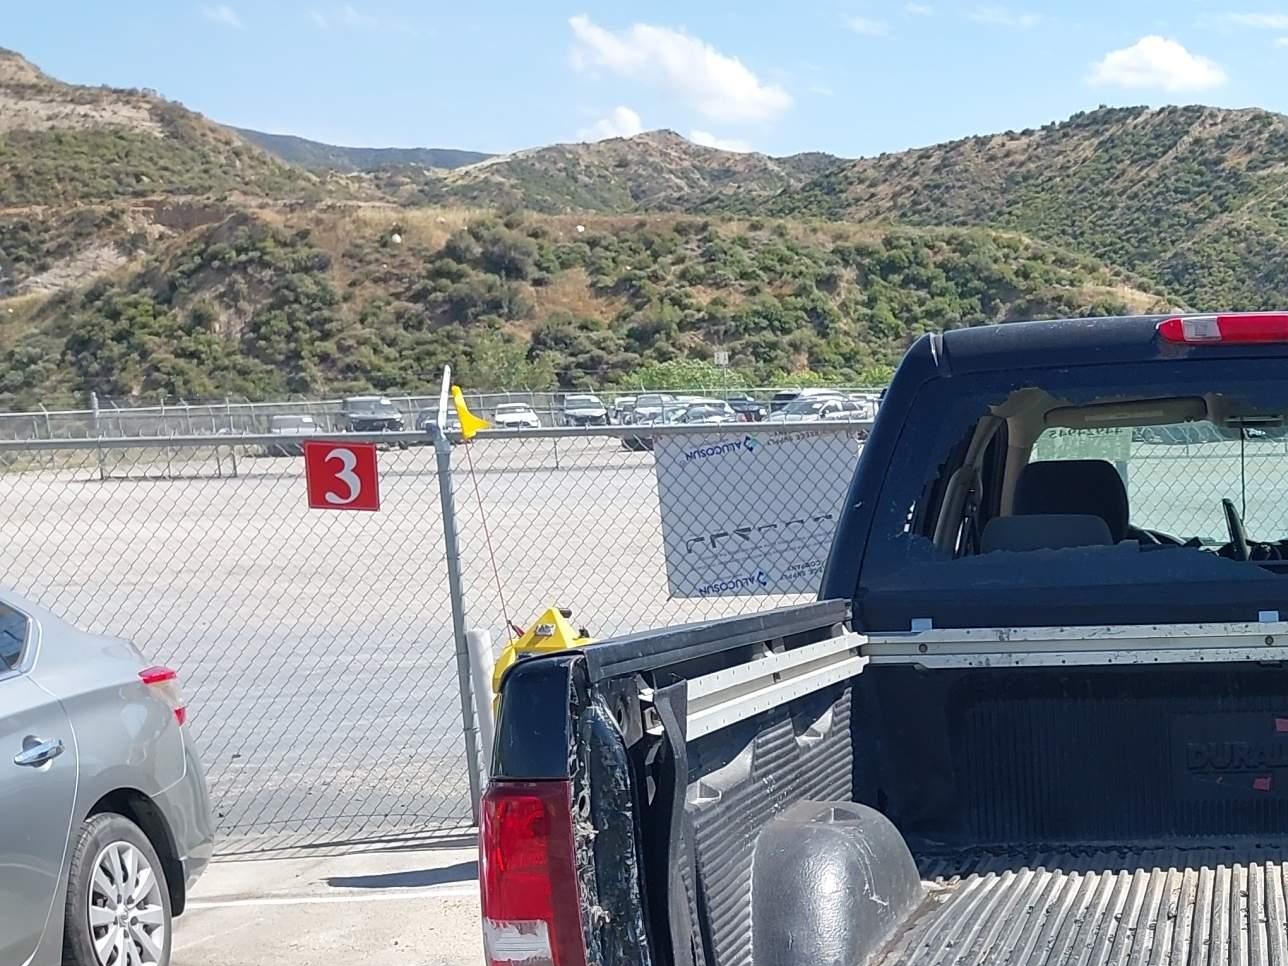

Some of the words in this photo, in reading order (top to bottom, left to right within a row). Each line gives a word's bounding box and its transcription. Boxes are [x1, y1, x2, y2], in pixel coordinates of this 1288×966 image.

[685, 442, 742, 461] ALUCOSUN
[323, 447, 362, 505] 3
[699, 576, 755, 596] ALUCOSUN
